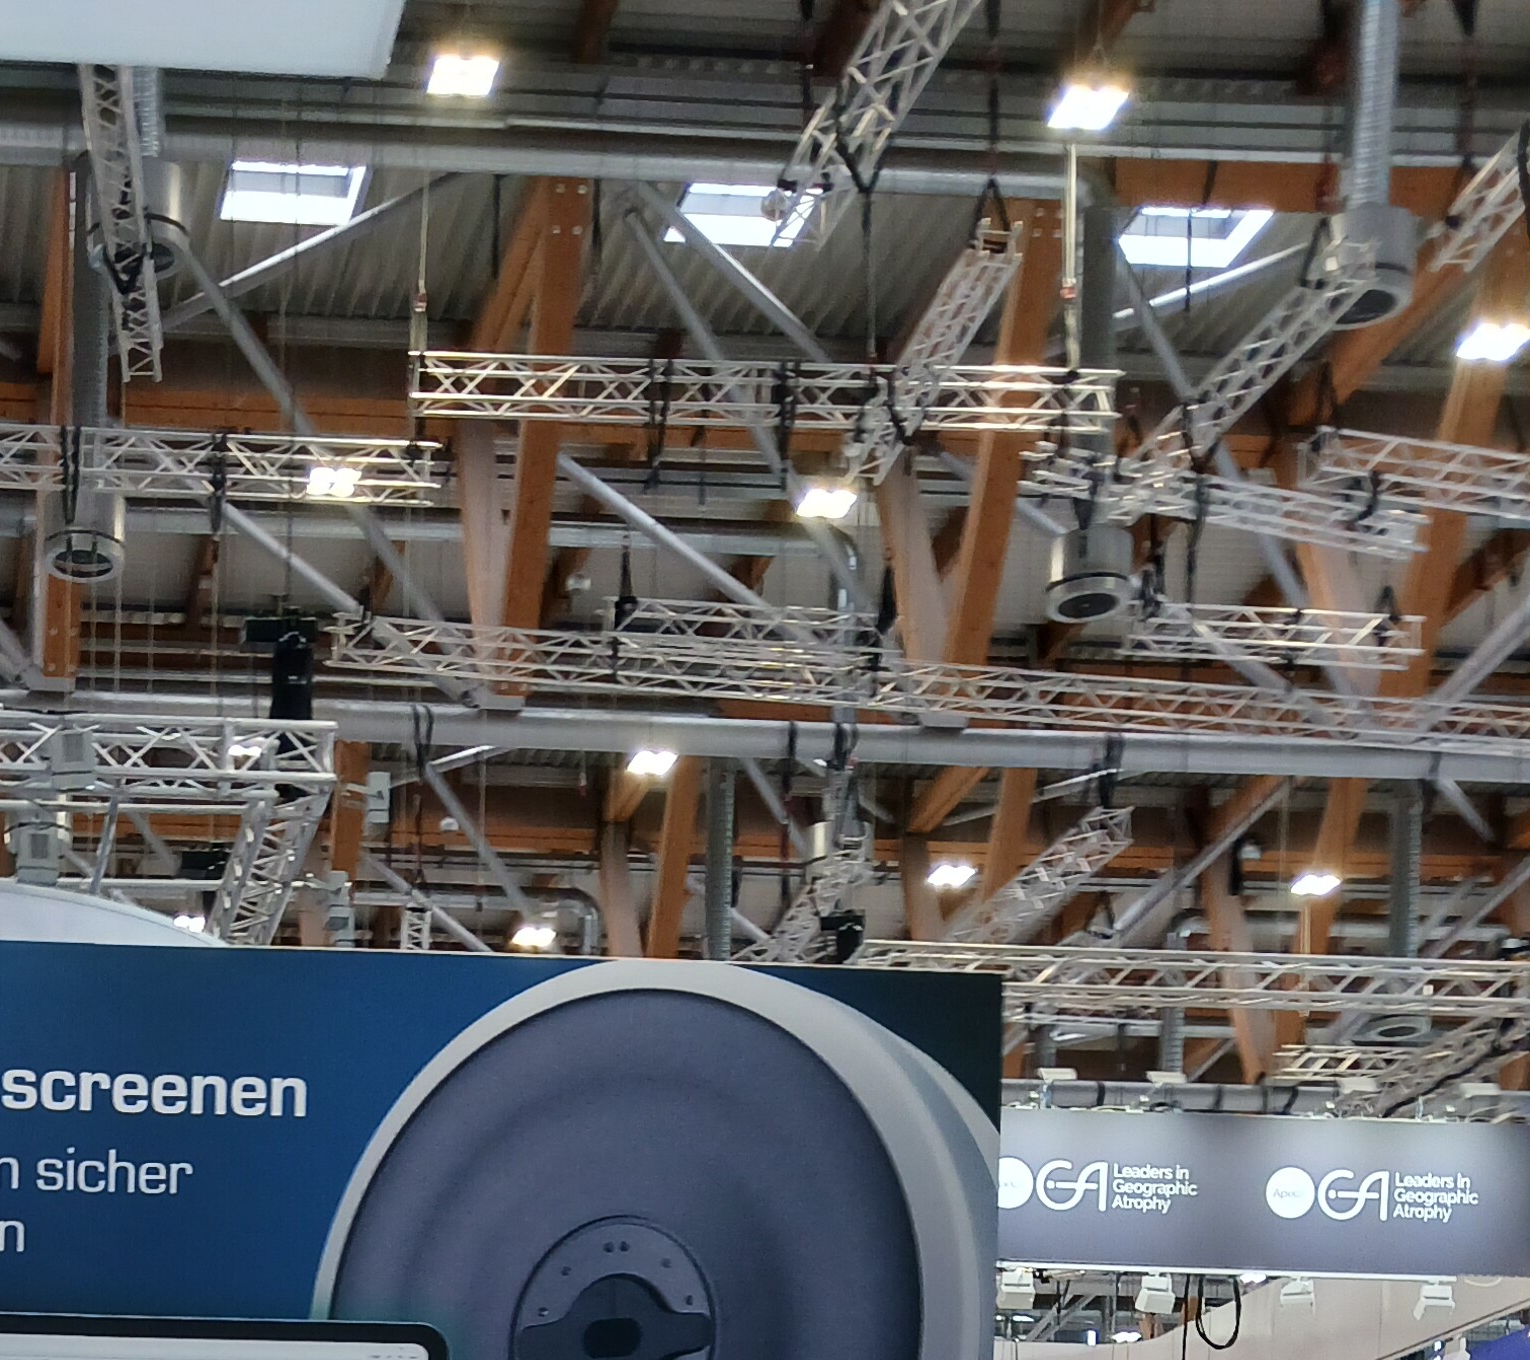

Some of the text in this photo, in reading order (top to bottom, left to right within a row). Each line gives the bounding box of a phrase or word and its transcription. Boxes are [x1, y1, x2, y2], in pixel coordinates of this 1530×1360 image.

[1, 1063, 308, 1117] screenen
[35, 1147, 194, 1196] sicher
[1113, 1162, 1190, 1180] Leaders in
[1395, 1171, 1455, 1188] Leaders
[1112, 1178, 1198, 1198] Geographic
[1393, 1187, 1479, 1208] Geographic
[1111, 1194, 1172, 1214] Atrophy
[1392, 1203, 1453, 1223] Atrophy
